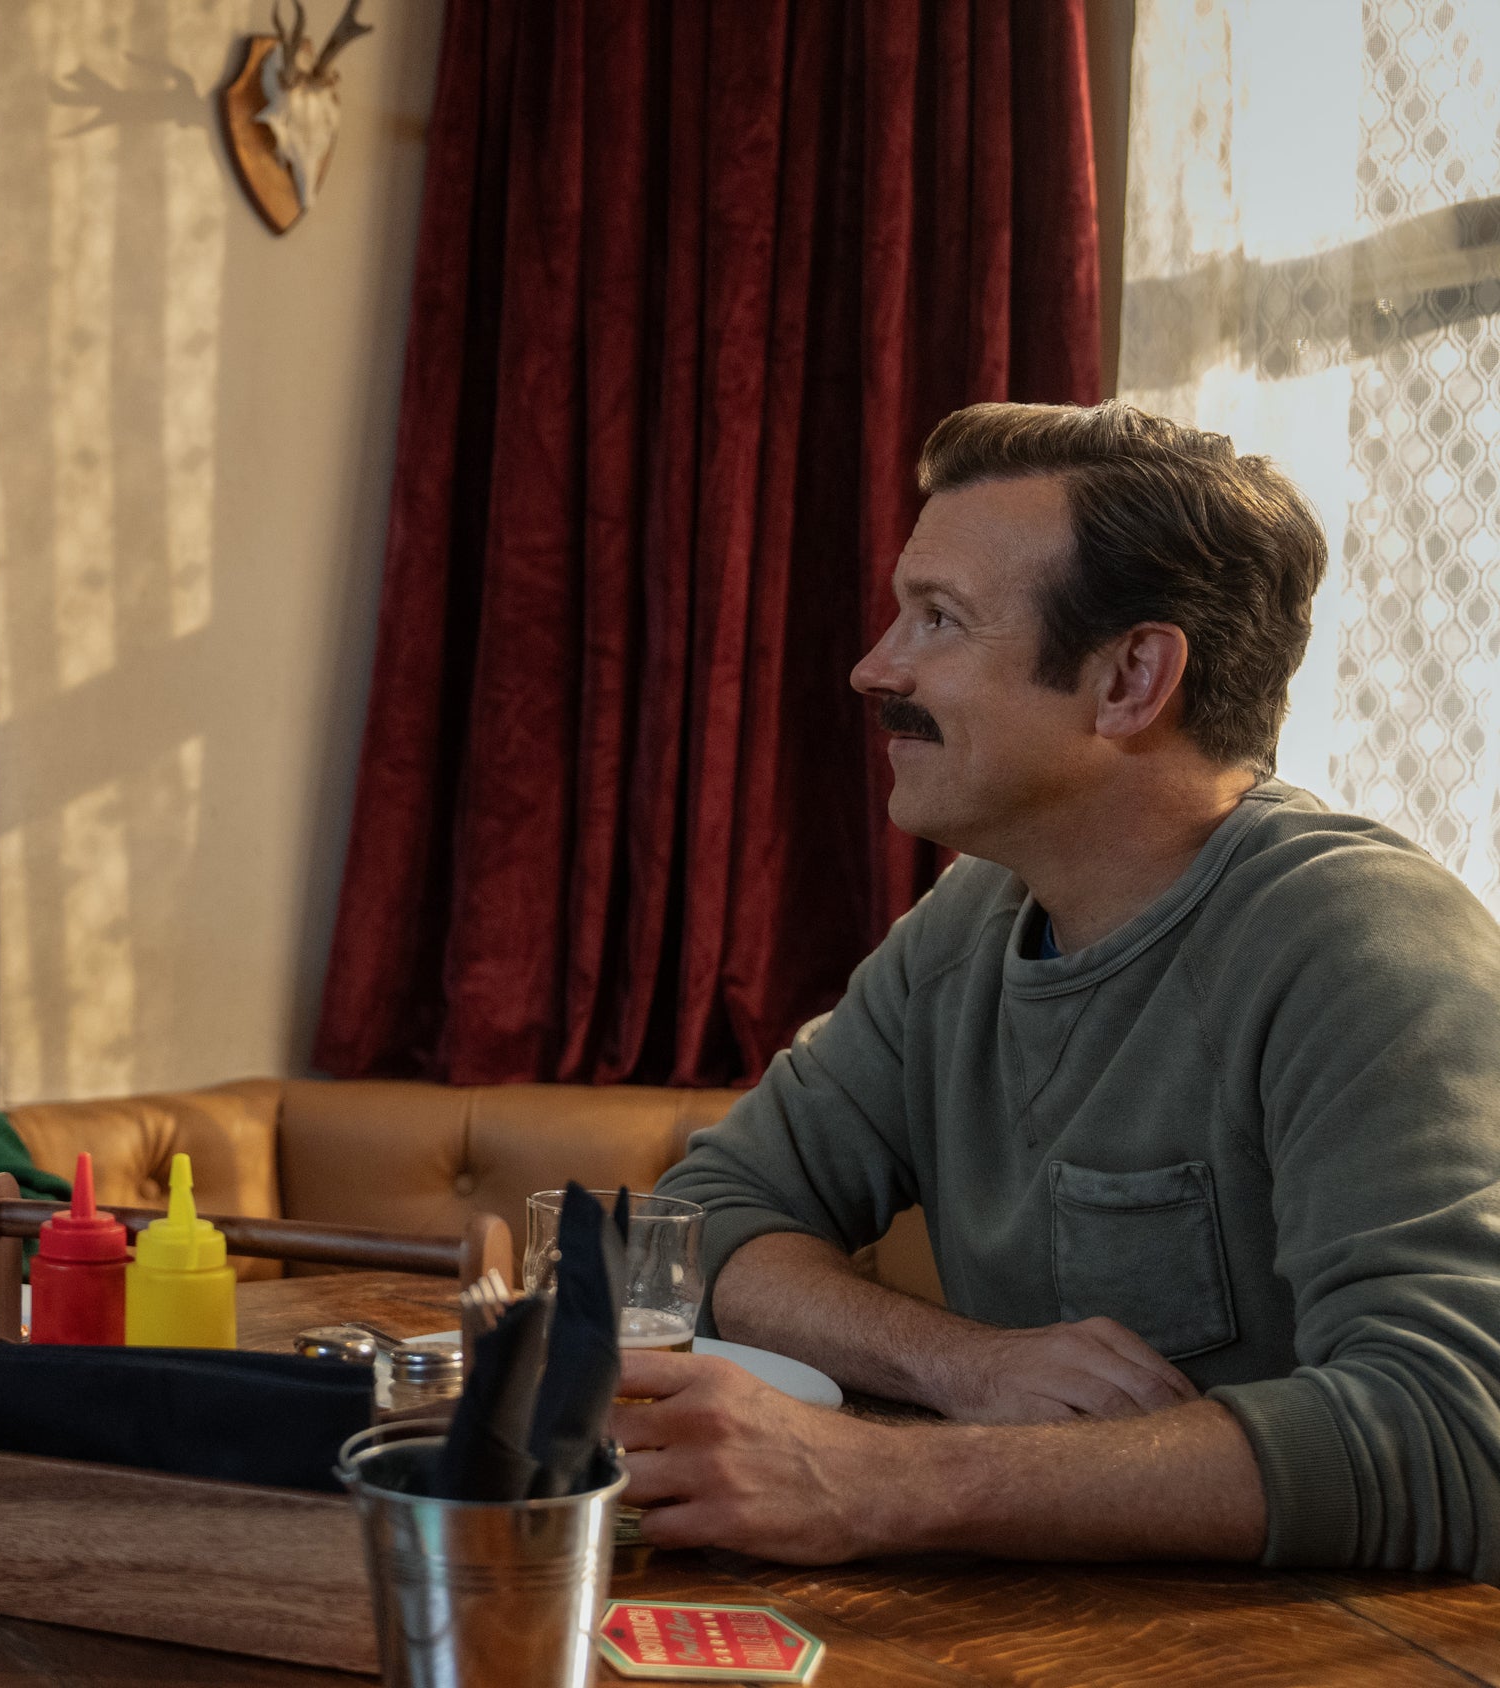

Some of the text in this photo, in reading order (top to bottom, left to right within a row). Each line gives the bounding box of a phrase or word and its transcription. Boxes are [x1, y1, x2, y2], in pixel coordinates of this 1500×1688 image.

[626, 1608, 668, 1663] NOTTLICH
[699, 1612, 735, 1664] GERMAN
[727, 1612, 786, 1667] PALE ALE
